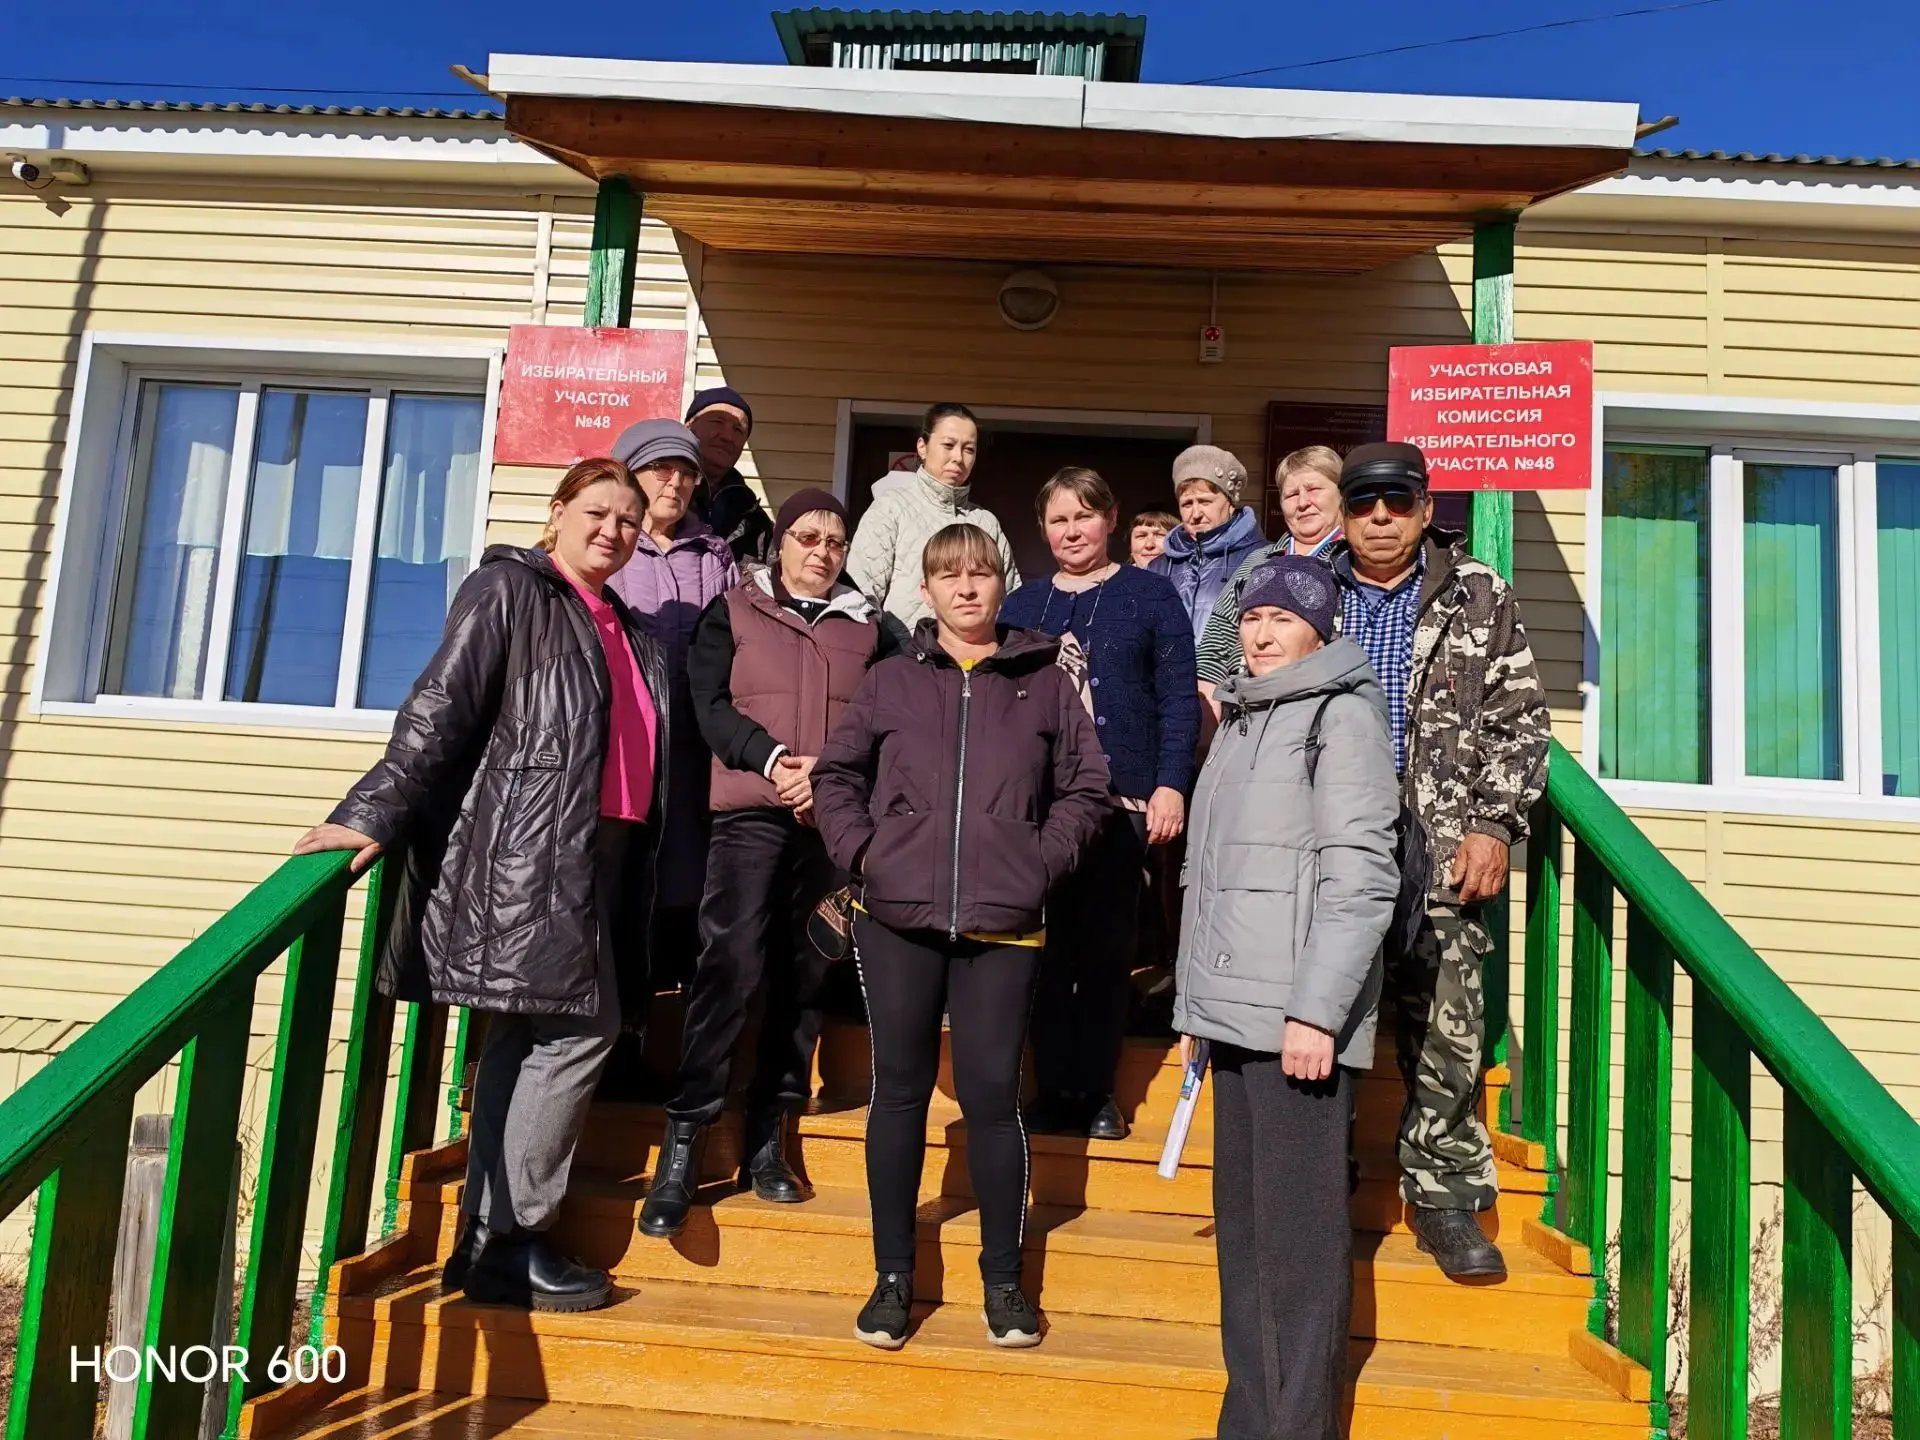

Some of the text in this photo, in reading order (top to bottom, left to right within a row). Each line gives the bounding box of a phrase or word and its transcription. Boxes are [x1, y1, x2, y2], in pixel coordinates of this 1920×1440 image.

[521, 365, 669, 384] ИЗБИРАТЕЛЬНЫЙ
[1429, 361, 1553, 377] УЧАСТКОВАЯ
[554, 390, 631, 407] УЧАСТОК
[1410, 385, 1571, 401] ИЗБИРАТЕЛЬНАЯ
[575, 415, 611, 429] №48
[1437, 409, 1542, 424] КОМИССИЯ
[1426, 456, 1555, 471] УЧАСТКА №48
